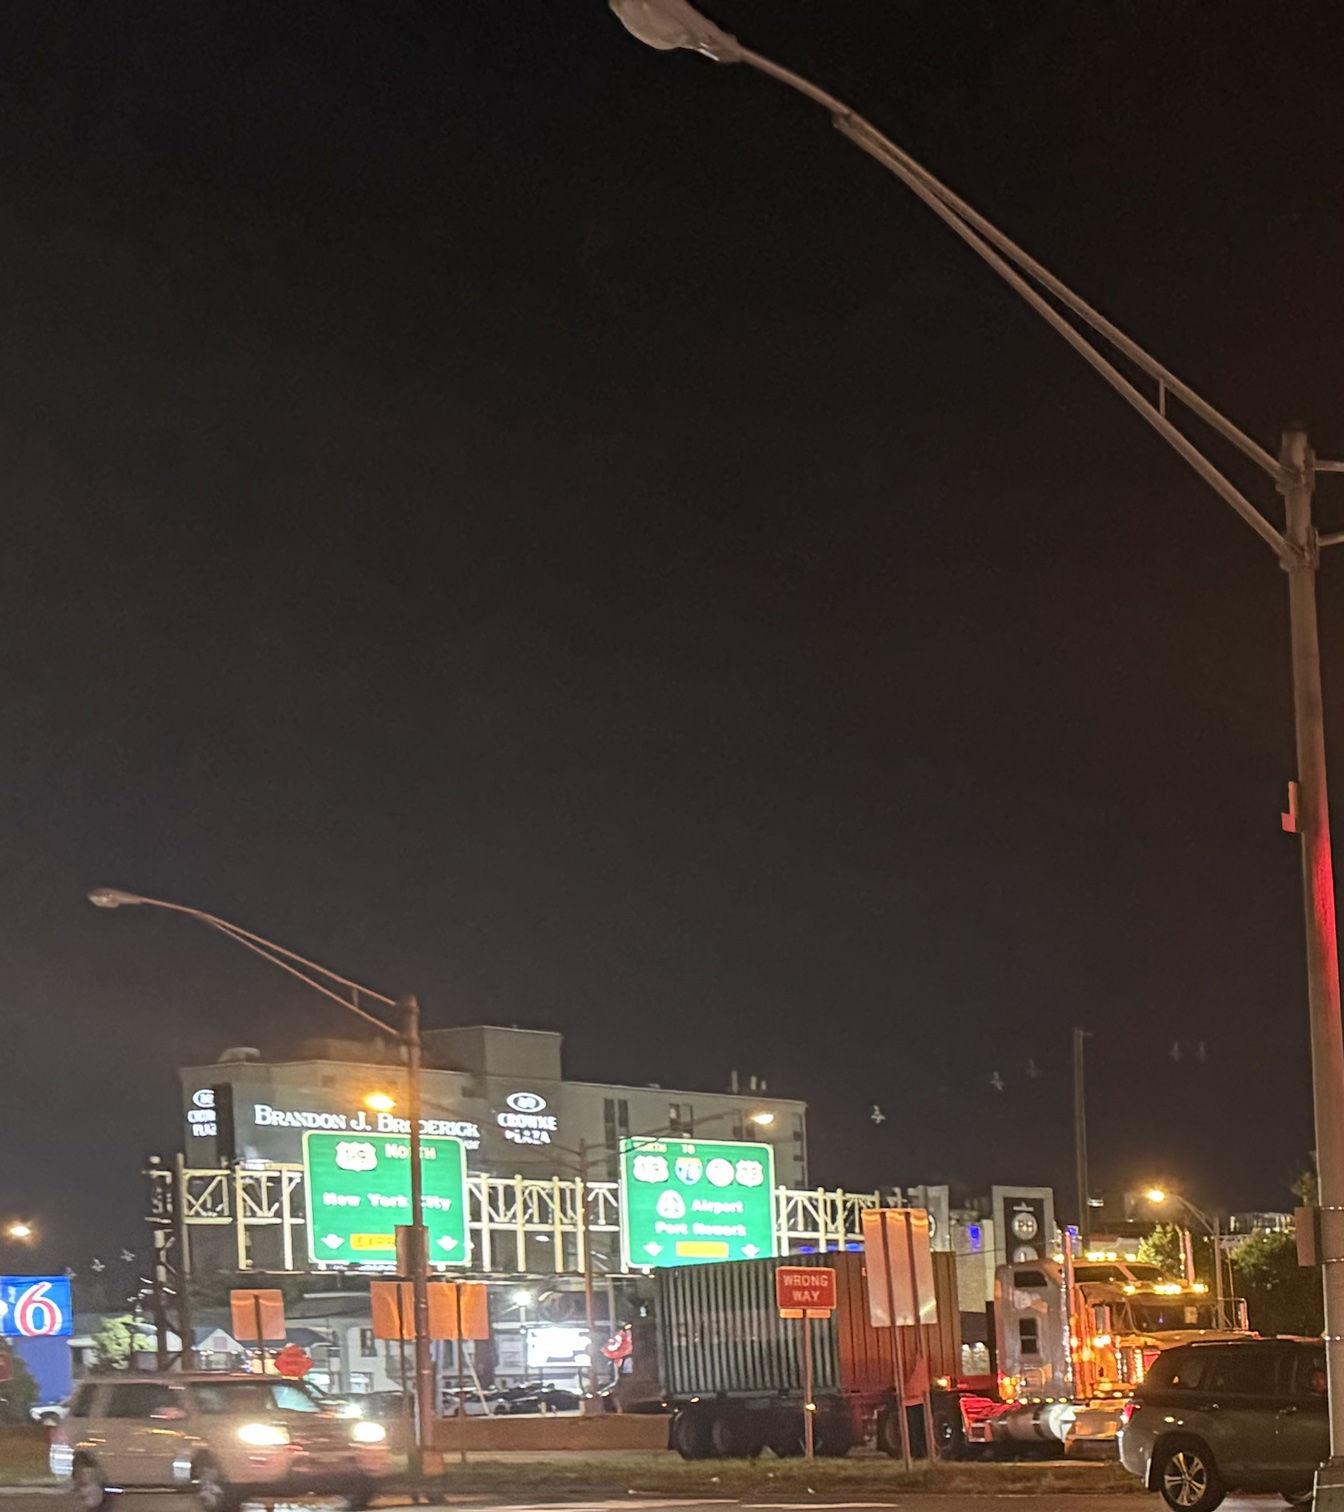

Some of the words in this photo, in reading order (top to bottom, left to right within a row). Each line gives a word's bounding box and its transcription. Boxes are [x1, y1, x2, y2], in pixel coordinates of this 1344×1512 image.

[253, 1104, 347, 1130] BRANDON
[349, 1110, 373, 1132] J.
[377, 1112, 480, 1138] BRDERICK
[497, 1113, 558, 1131] CROWNE
[504, 1129, 551, 1145] PLAZA
[384, 1143, 437, 1160] NOTH
[322, 1192, 361, 1207] New
[366, 1193, 409, 1208] York
[691, 1198, 744, 1215] Airport
[654, 1221, 689, 1236] Port
[692, 1222, 747, 1237] Newark
[782, 1274, 829, 1287] WRONG
[792, 1289, 820, 1302] WAY
[13, 1281, 64, 1337] 6
